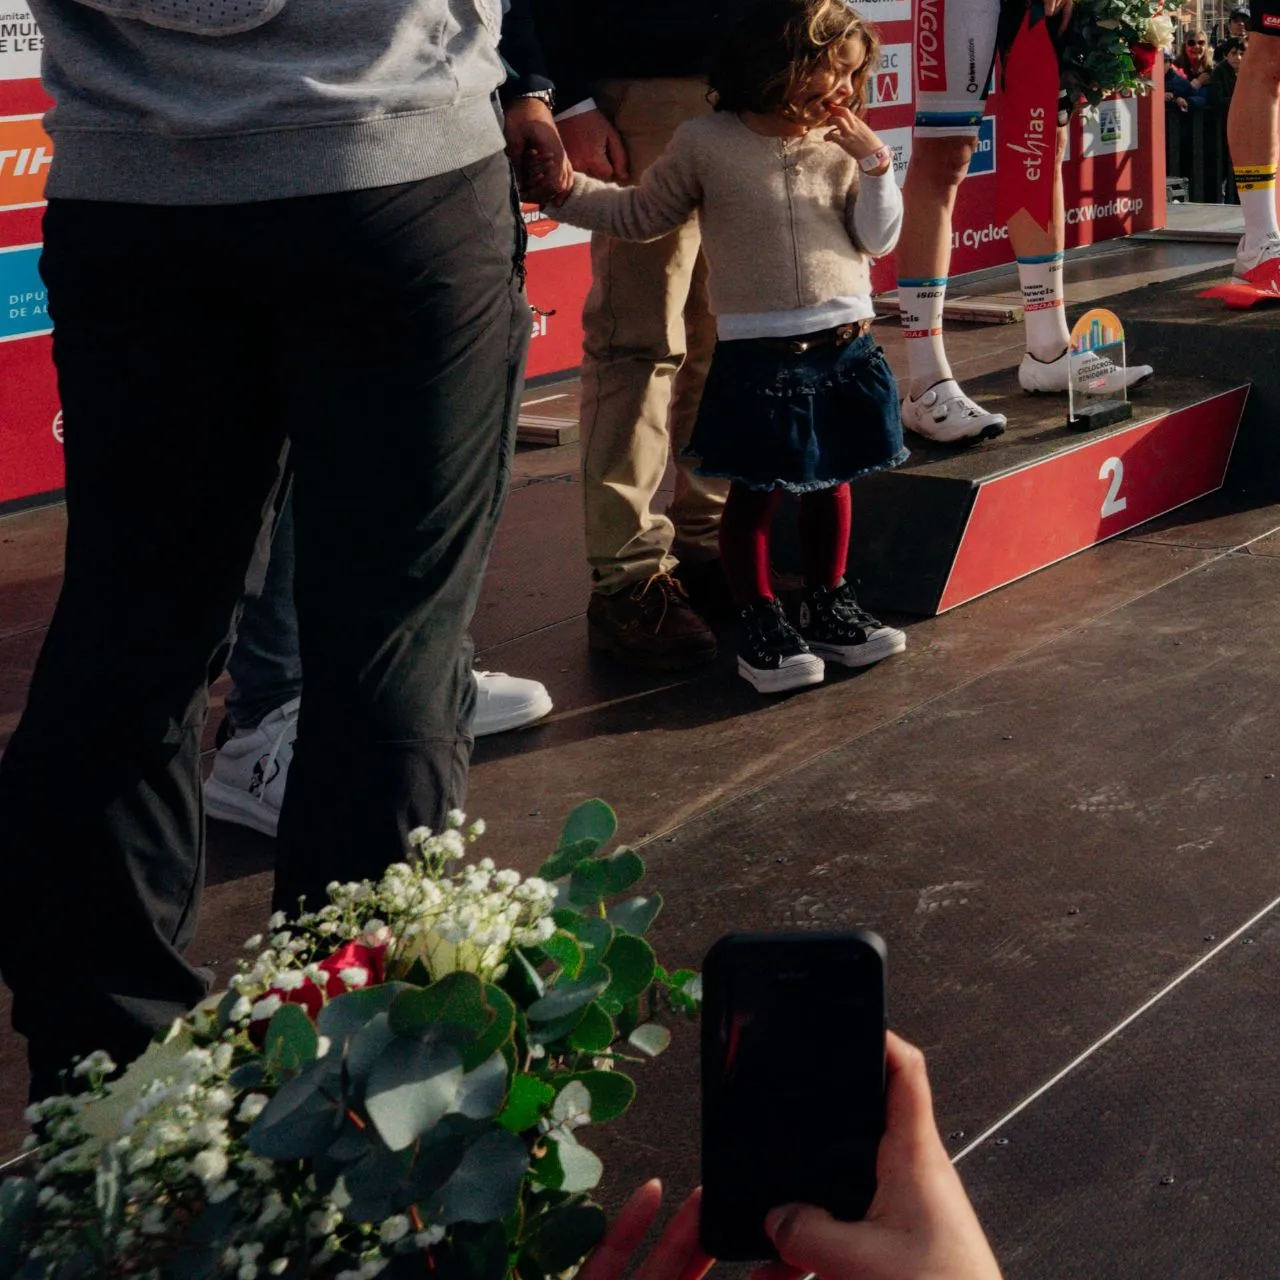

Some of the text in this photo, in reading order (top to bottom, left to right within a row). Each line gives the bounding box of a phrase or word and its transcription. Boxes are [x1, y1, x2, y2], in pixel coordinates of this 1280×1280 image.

[1006, 107, 1049, 181] ethias
[962, 223, 1009, 249] Cycloc
[1097, 456, 1128, 519] 2
